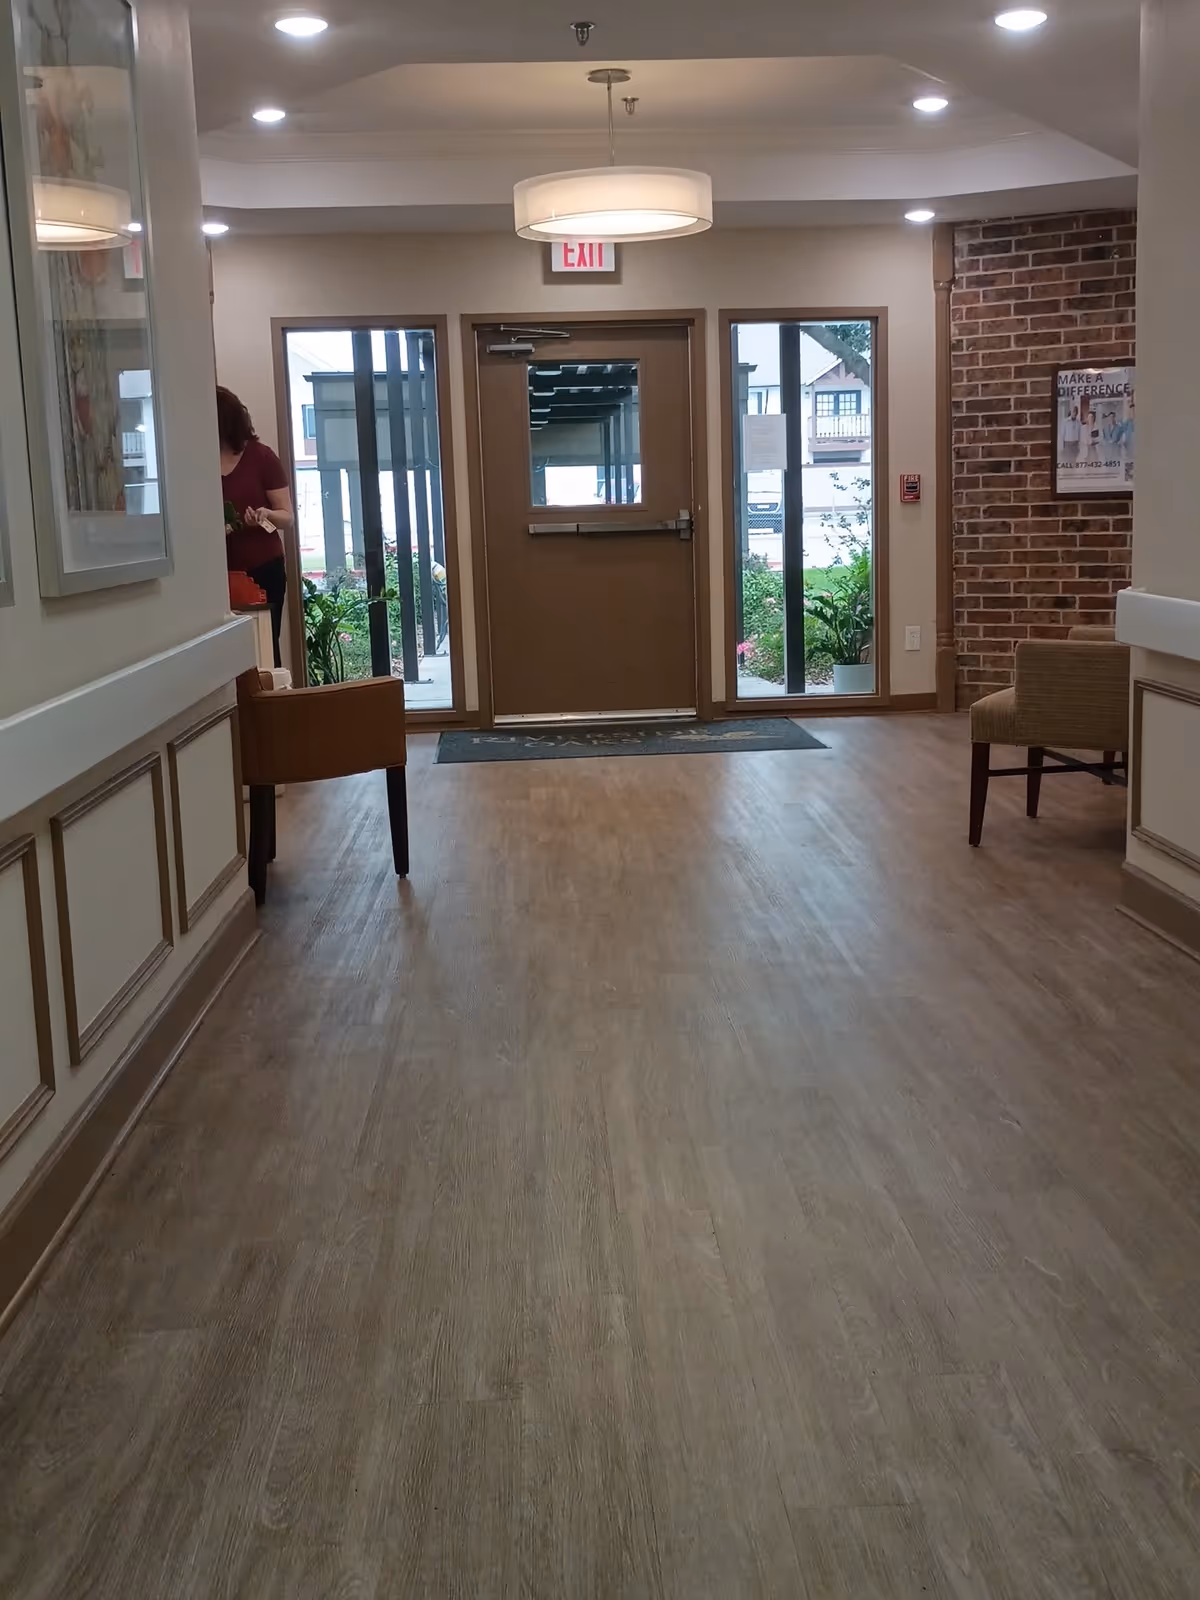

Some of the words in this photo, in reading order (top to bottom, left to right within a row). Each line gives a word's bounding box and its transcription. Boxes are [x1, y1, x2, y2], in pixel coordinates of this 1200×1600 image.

[1058, 373, 1091, 385] MAKE
[1095, 373, 1103, 383] A
[1058, 383, 1131, 397] DIFFERENCE
[1056, 462, 1074, 470] CALL
